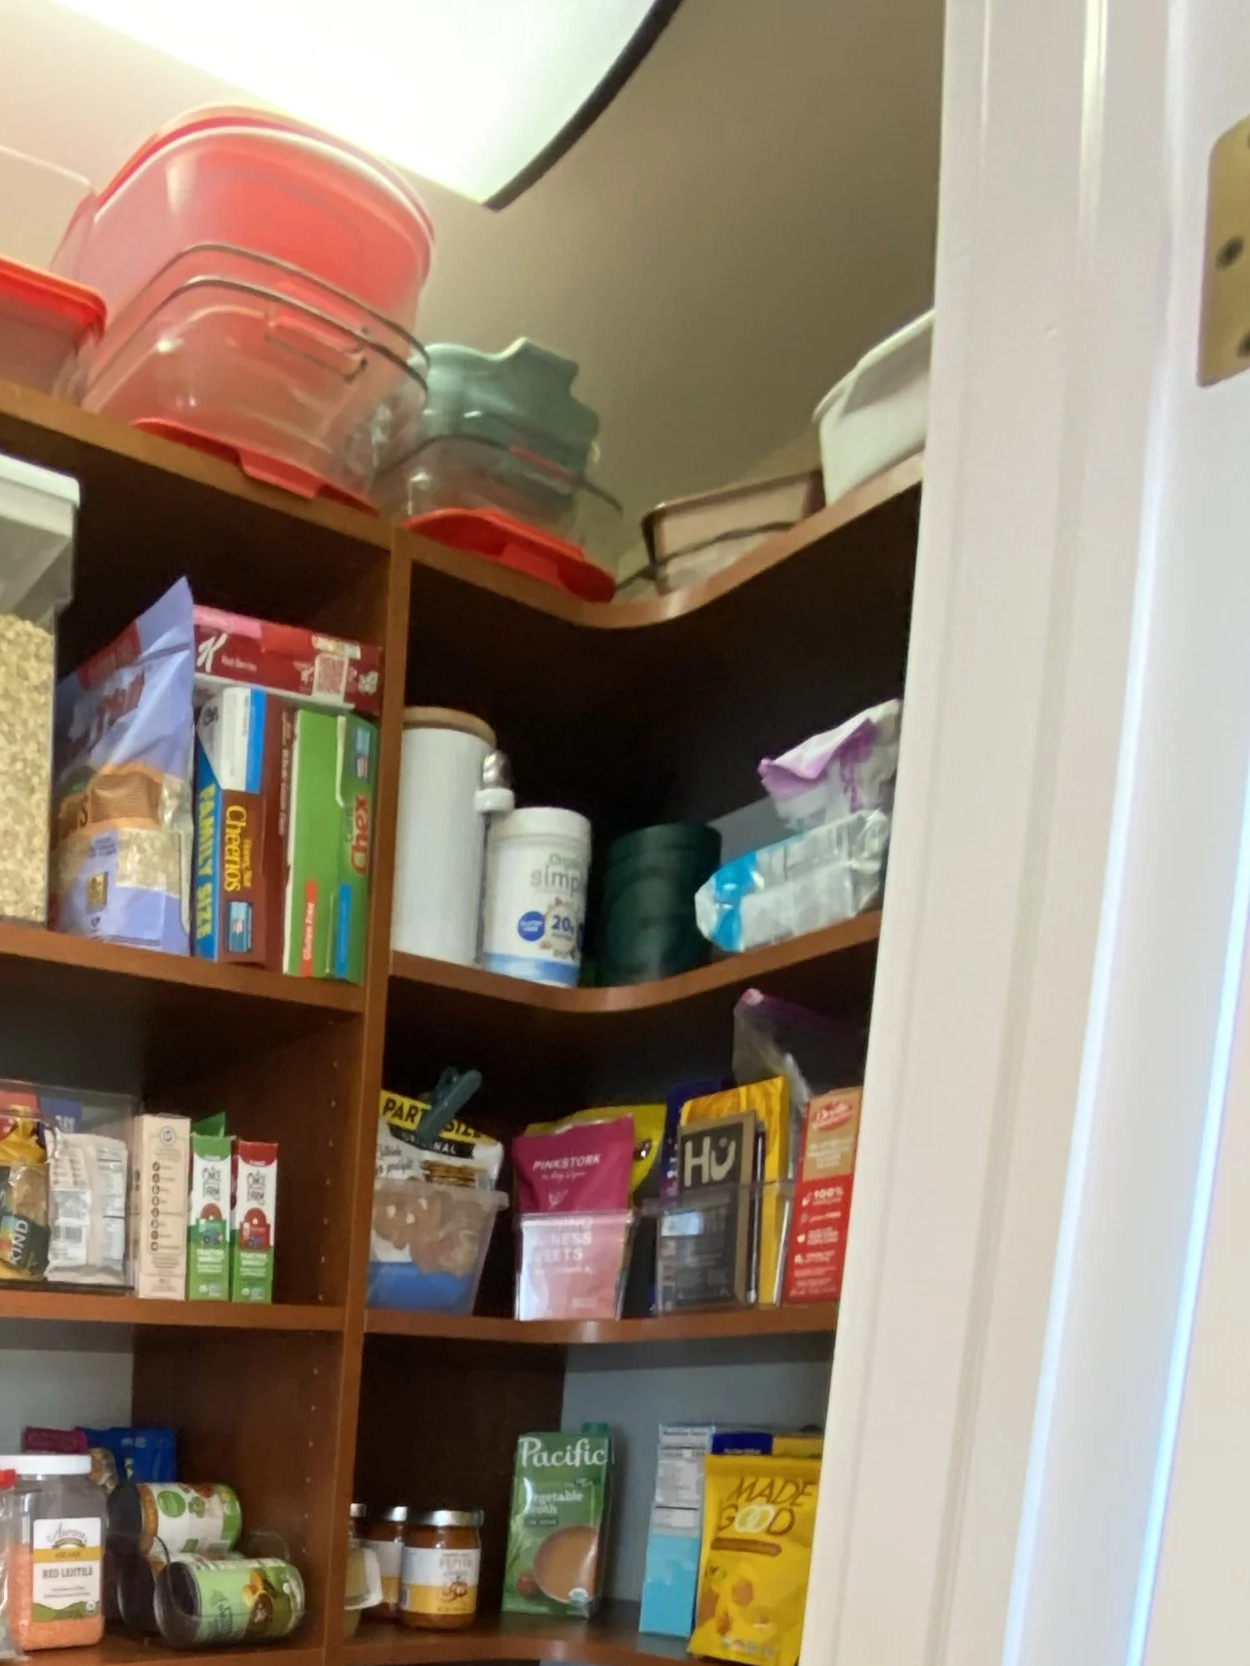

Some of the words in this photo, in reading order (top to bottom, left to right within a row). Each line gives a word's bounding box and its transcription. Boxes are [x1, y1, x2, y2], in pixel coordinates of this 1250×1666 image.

[196, 784, 217, 877] FAMILY
[350, 795, 369, 875] Chex
[223, 804, 247, 894] Cheerios
[195, 882, 213, 940] SIZE
[304, 901, 315, 924] Free
[303, 926, 314, 961] Gluten
[382, 1097, 429, 1124] PART
[9, 1219, 30, 1266] KIND
[517, 1436, 608, 1468] Pacific
[730, 1474, 815, 1507] MADE
[717, 1502, 796, 1536] GOOD
[42, 1566, 59, 1578] RED
